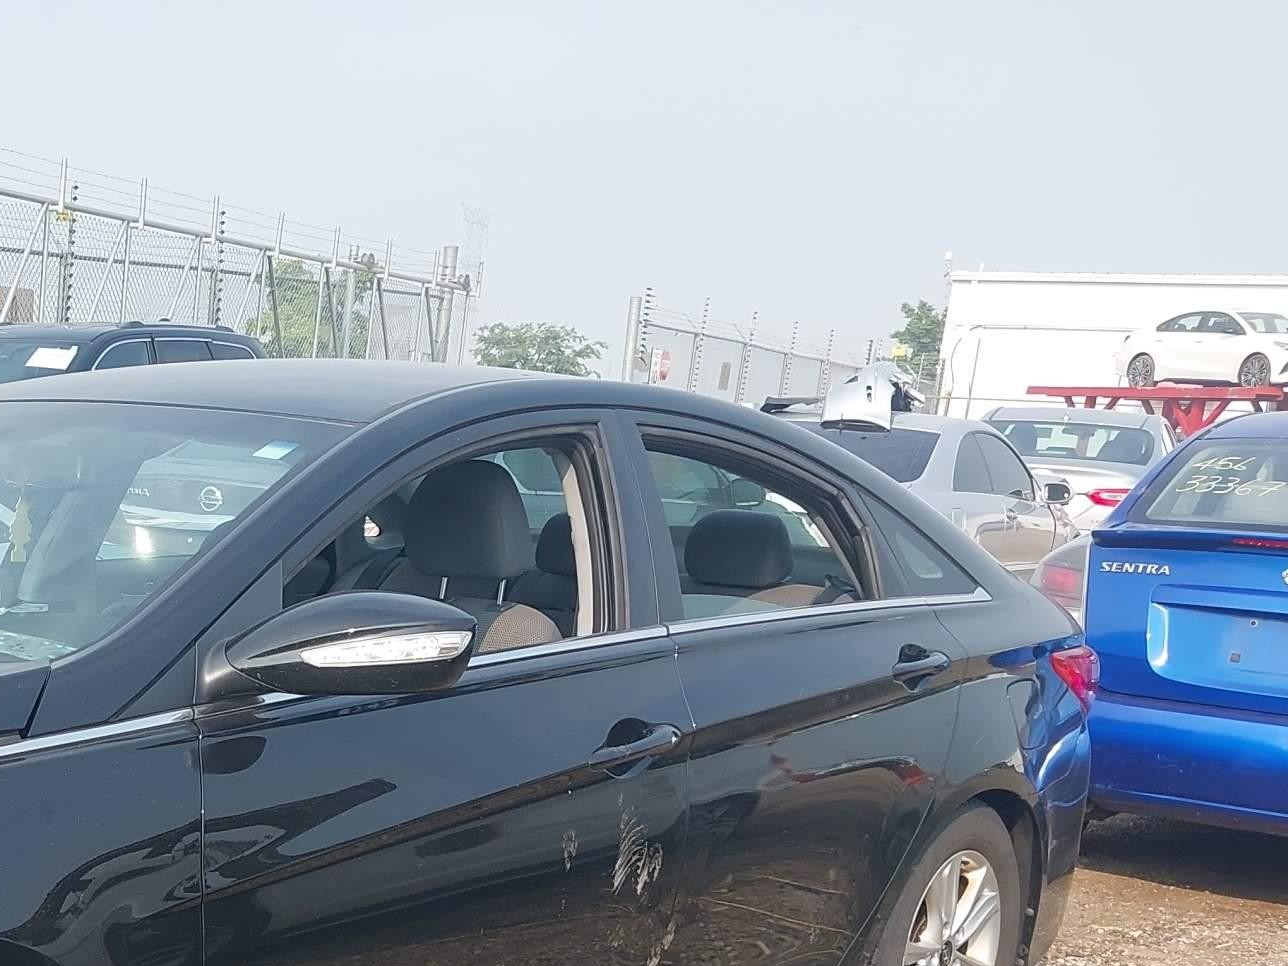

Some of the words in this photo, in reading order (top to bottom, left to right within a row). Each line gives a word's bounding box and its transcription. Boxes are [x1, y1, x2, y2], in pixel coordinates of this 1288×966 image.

[1191, 456, 1257, 471] 456
[1175, 475, 1288, 496] 33367
[1099, 561, 1170, 576] SENTRA
